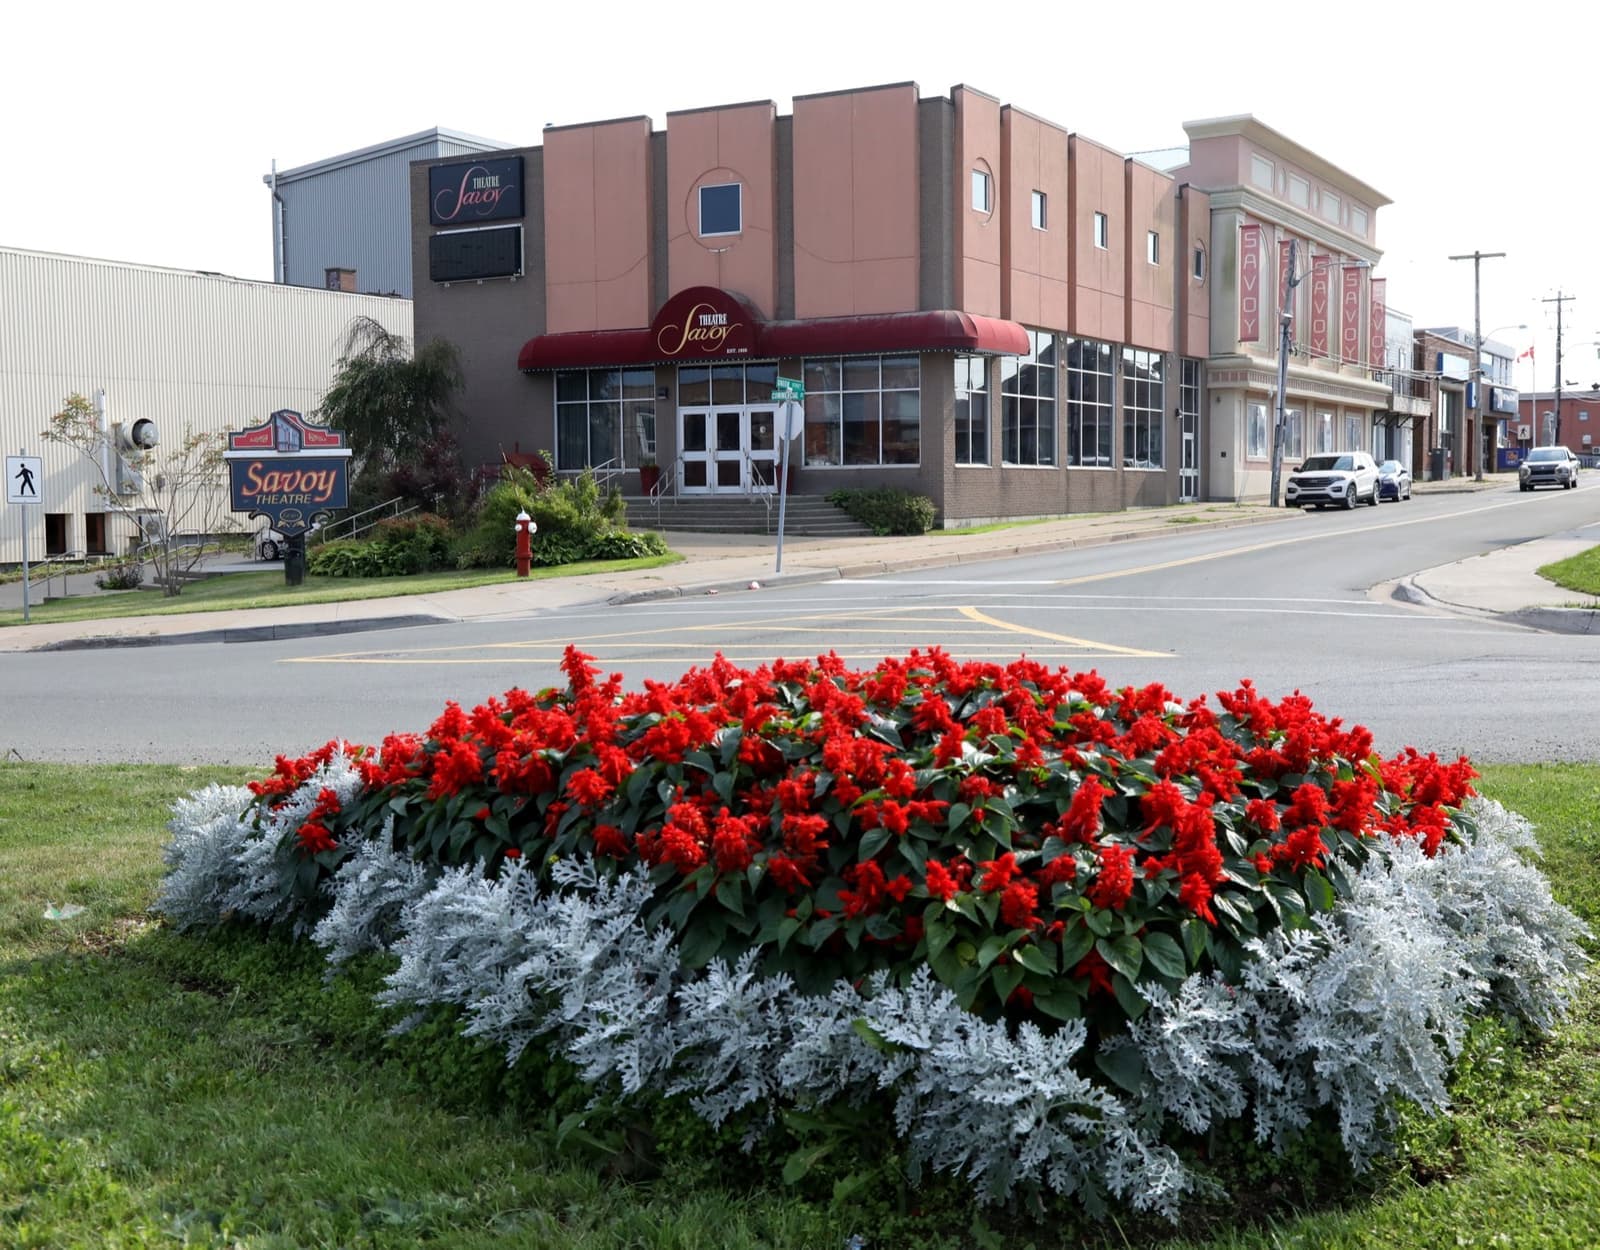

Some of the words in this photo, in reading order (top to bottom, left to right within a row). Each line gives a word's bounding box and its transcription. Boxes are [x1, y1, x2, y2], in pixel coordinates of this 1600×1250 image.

[434, 166, 515, 220] Savoy
[473, 175, 500, 190] THEATRE
[1243, 231, 1257, 334] SAVOY
[1313, 261, 1327, 353] SAVOY
[657, 303, 744, 355] Savoy
[698, 313, 728, 326] THEATRE
[1344, 273, 1358, 363] SAVOY
[241, 460, 338, 503] Savoy
[255, 493, 313, 505] THEATRE
